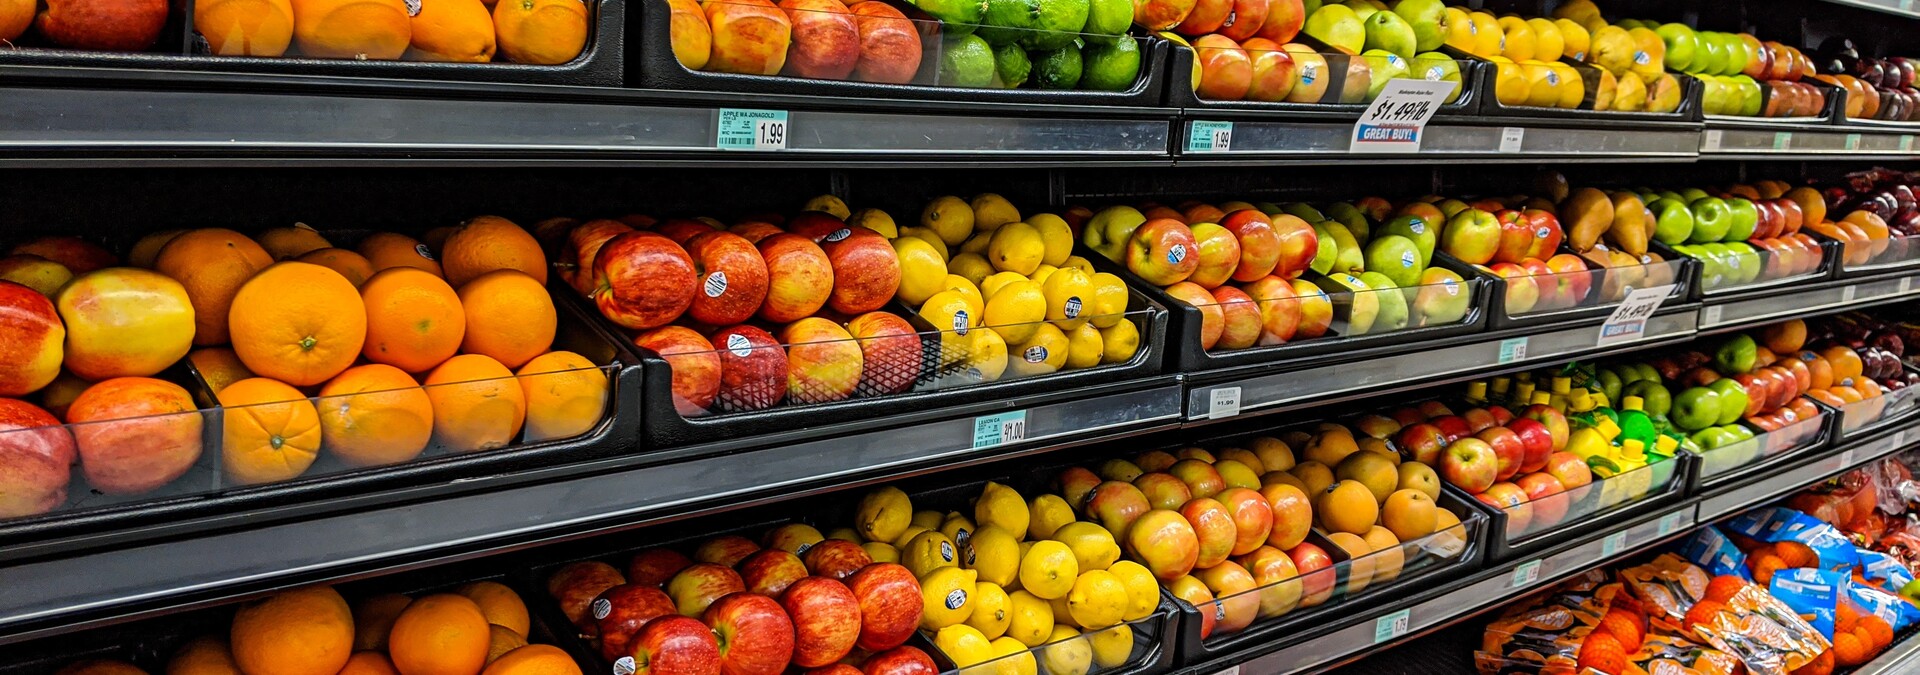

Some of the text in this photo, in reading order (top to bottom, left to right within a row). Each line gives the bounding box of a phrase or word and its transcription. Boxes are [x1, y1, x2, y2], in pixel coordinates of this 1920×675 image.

[761, 122, 784, 145] 1.99
[1215, 131, 1230, 149] 1.99
[1363, 127, 1414, 140] GREAT BUY!
